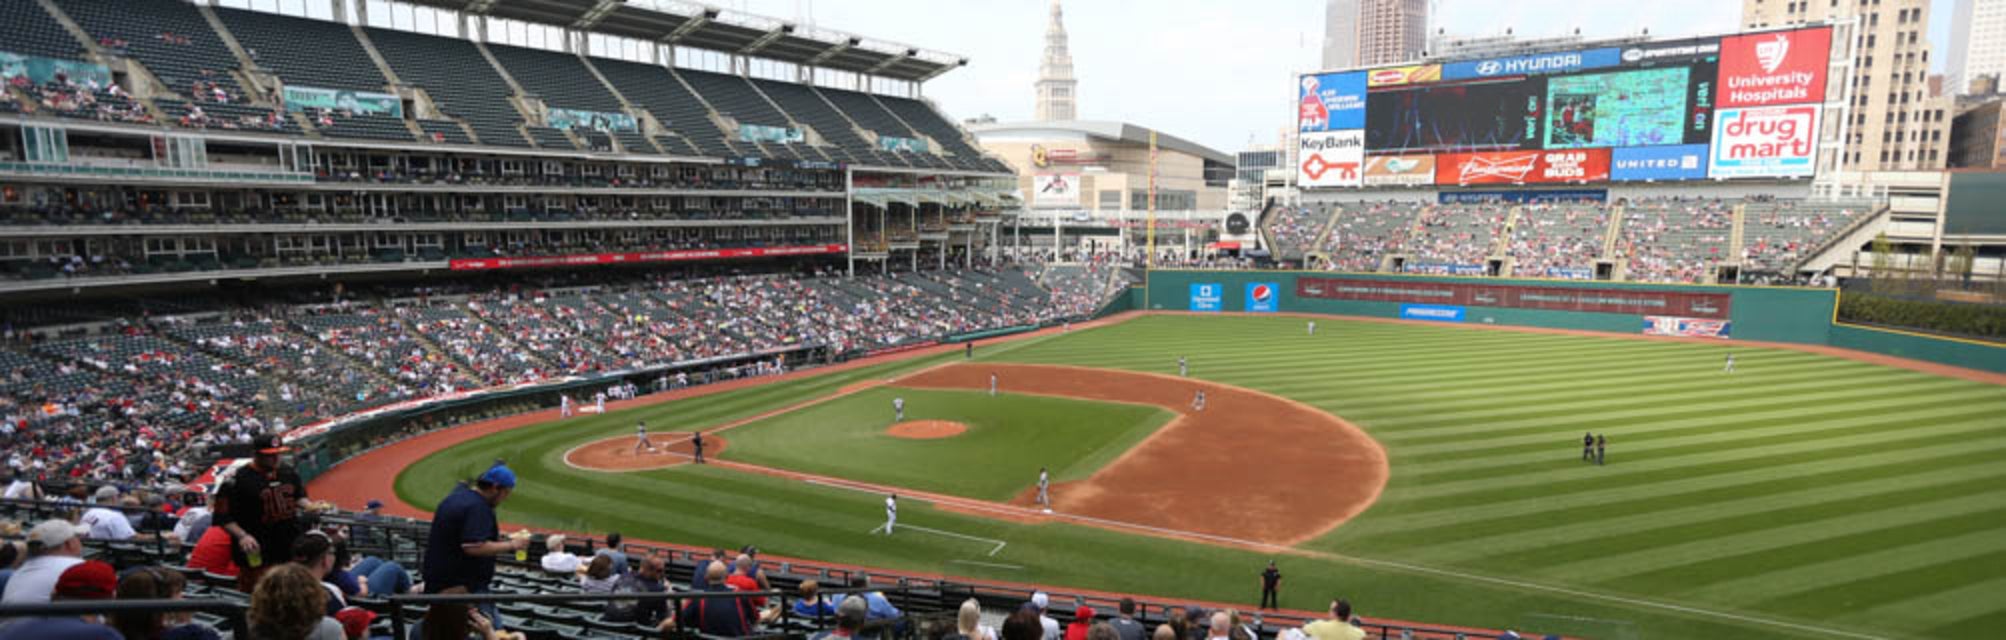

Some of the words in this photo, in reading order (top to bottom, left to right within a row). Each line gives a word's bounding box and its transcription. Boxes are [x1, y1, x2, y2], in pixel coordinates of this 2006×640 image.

[1505, 53, 1581, 72] HYUNDAI
[1728, 71, 1814, 88] University
[1730, 85, 1807, 103] Hospitals
[1726, 110, 1797, 140] drug
[1301, 135, 1361, 150] KeyBank
[1730, 138, 1804, 158] mart
[1545, 152, 1586, 163] GRAB
[1616, 158, 1679, 170] UNITED
[1544, 167, 1585, 177] BUDS
